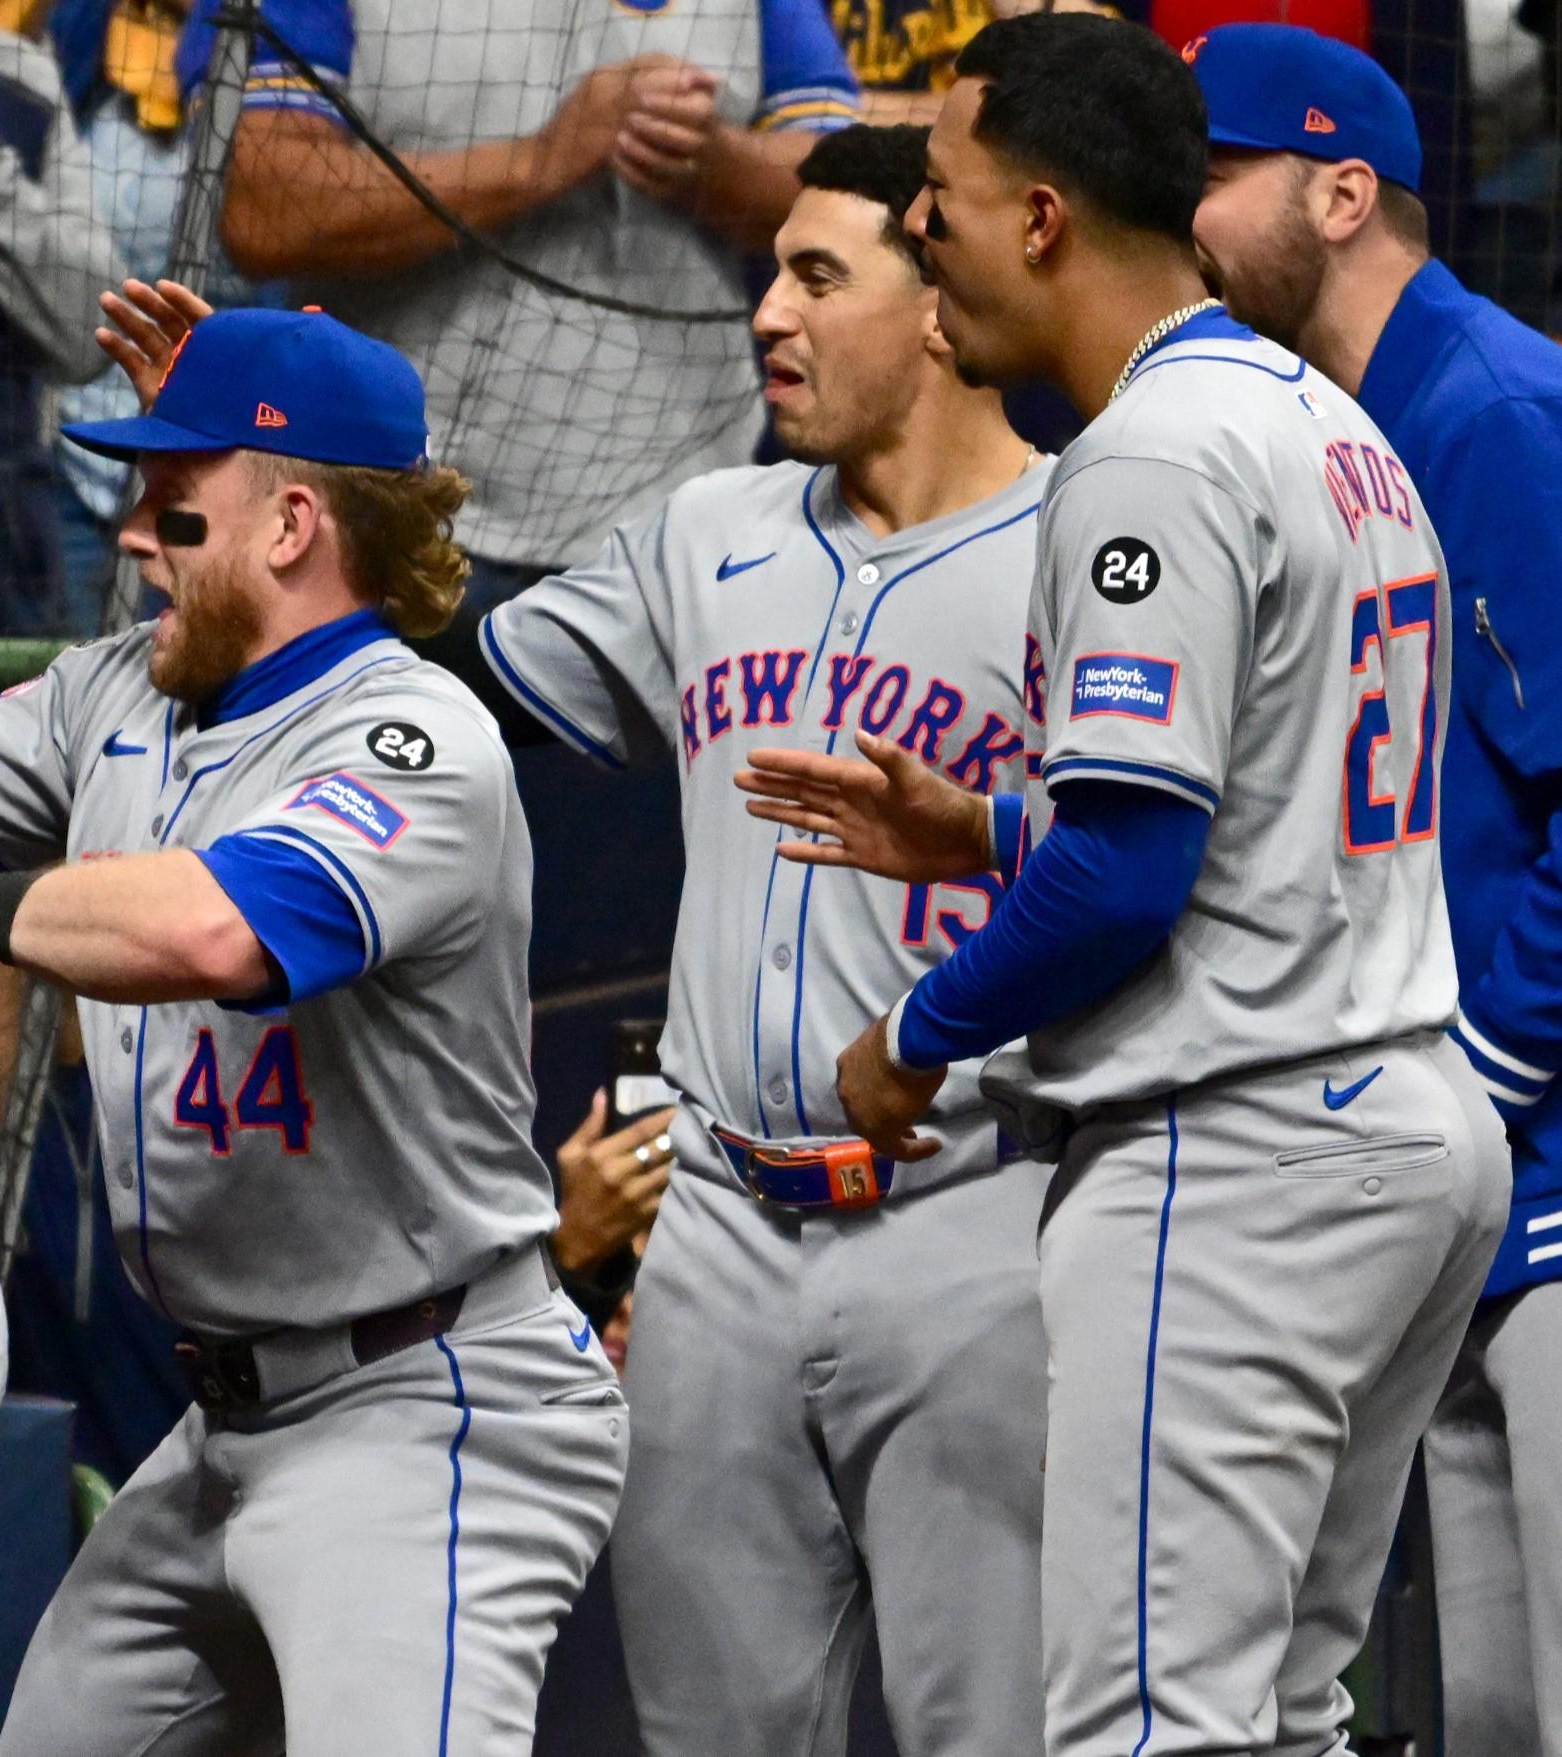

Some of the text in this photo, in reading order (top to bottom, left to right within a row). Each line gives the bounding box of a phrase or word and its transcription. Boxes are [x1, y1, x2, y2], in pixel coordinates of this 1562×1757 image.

[1101, 550, 1150, 592] 24
[1083, 681, 1165, 706] Presbyterian
[1085, 666, 1148, 685] NewYork-
[679, 649, 811, 776] NEW
[821, 654, 1025, 798] YORK
[1342, 570, 1439, 857] 27
[374, 727, 427, 768] 24
[173, 1024, 316, 1157] 44
[838, 1163, 870, 1200] 15
